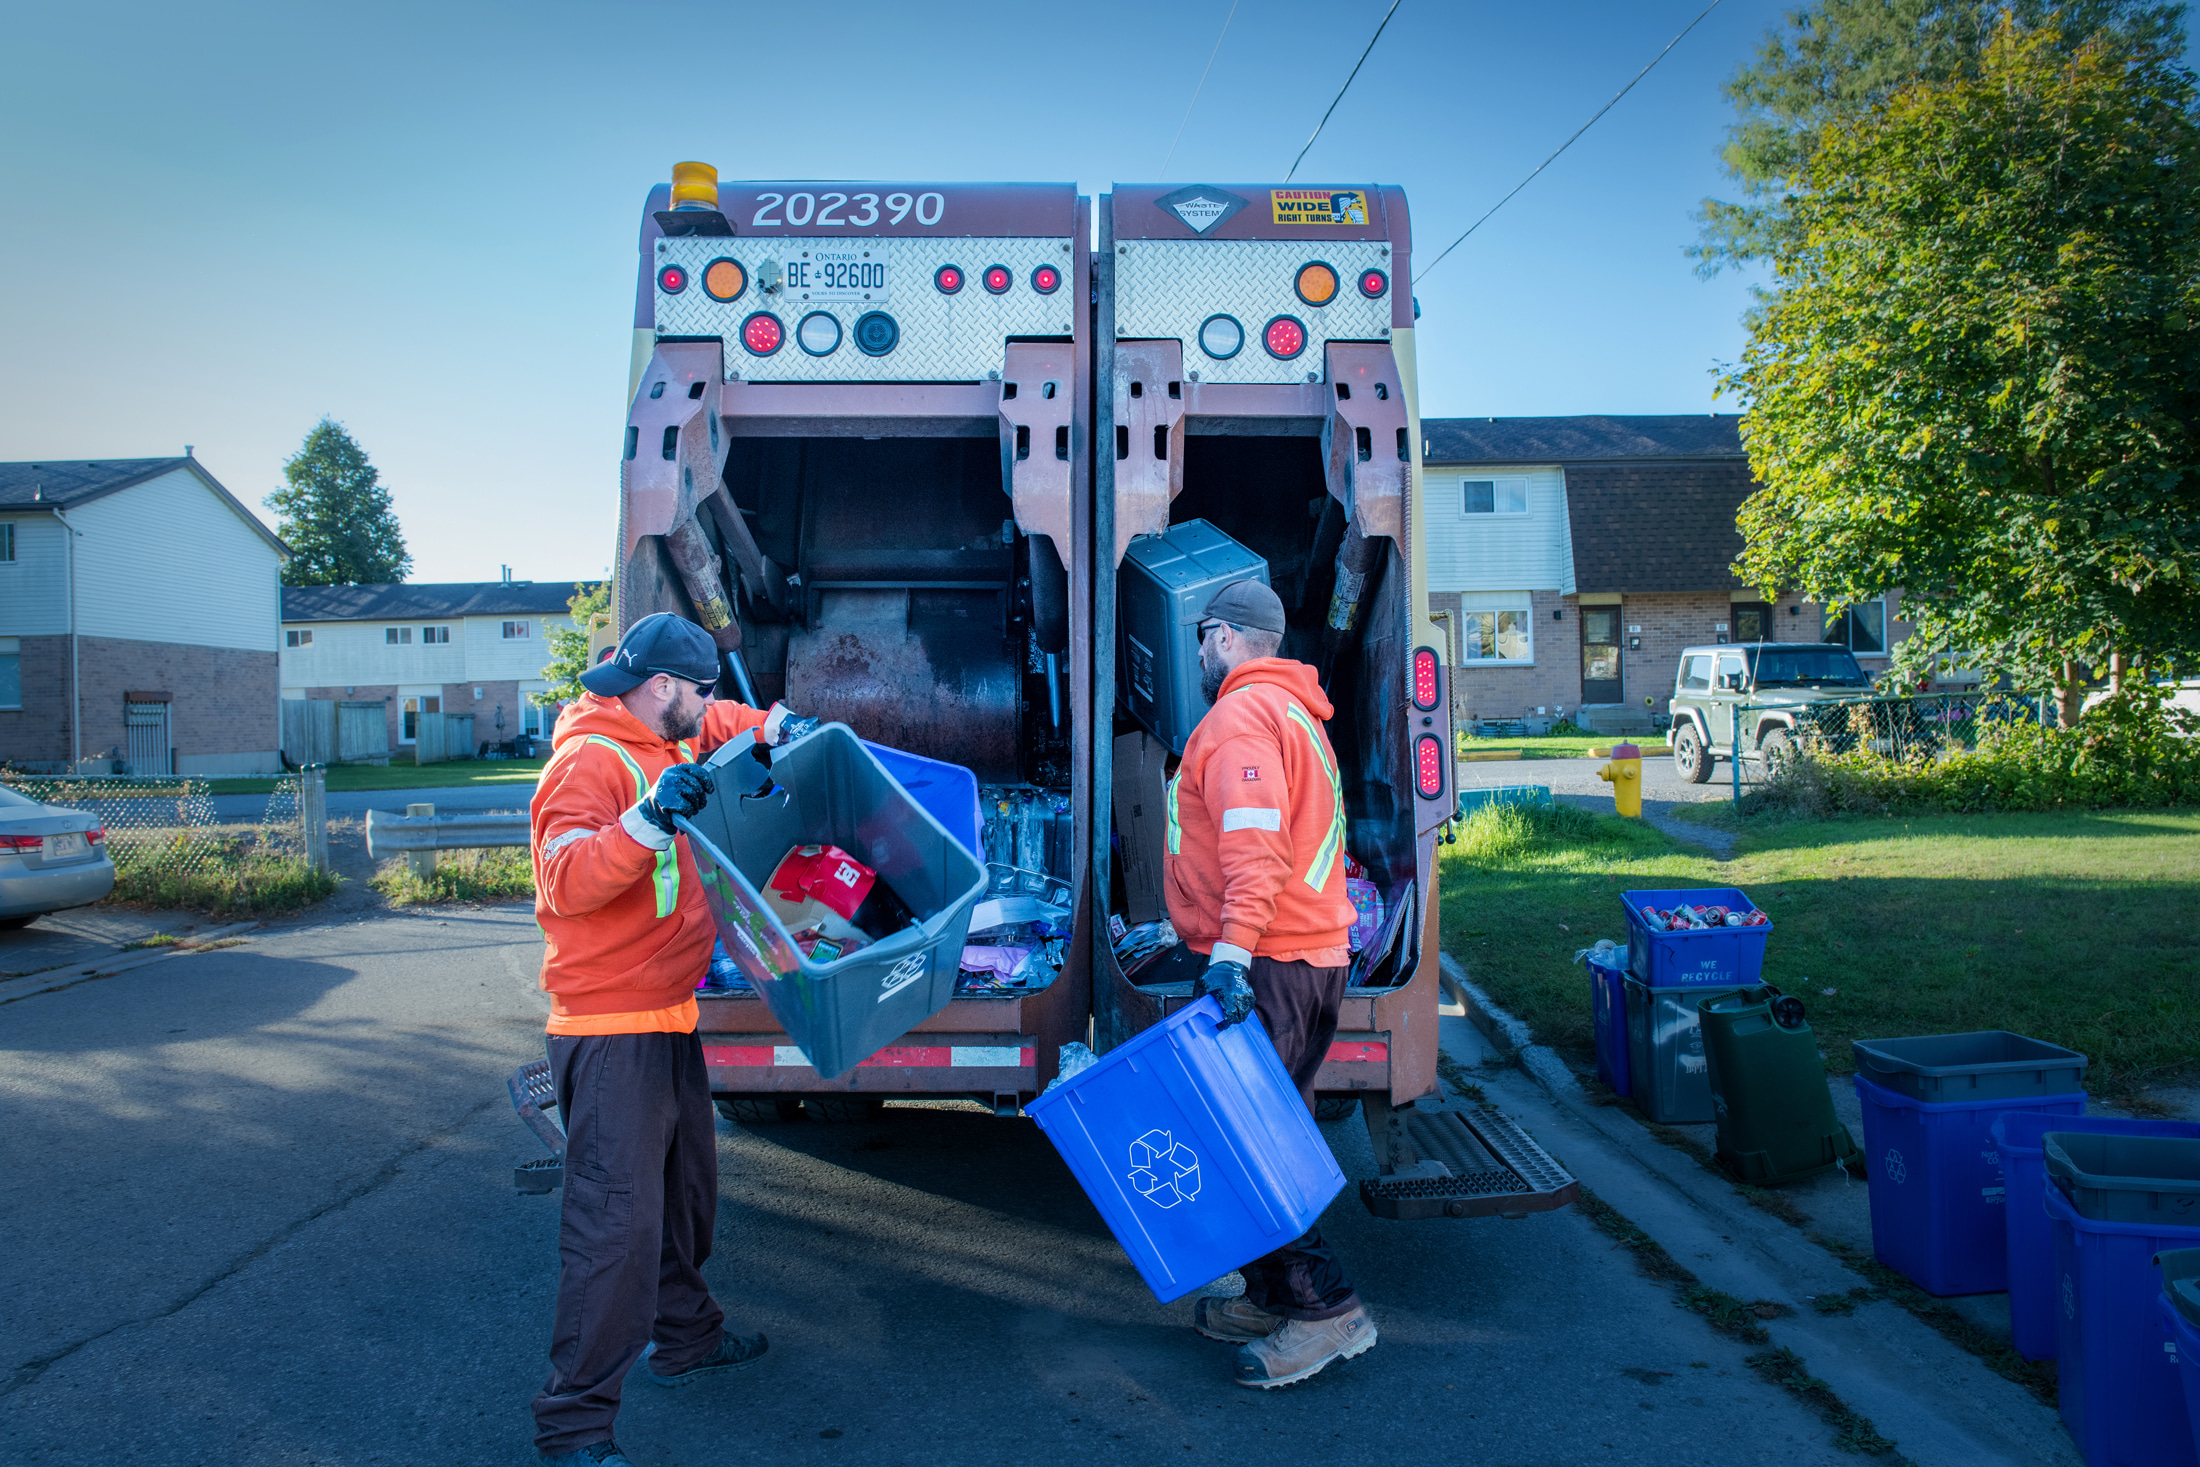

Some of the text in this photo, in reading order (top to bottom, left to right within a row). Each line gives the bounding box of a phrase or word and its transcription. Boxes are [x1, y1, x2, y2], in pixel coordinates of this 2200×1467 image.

[1275, 191, 1331, 200] CAUTION
[752, 192, 945, 227] 202390
[1277, 202, 1330, 211] WIDE
[1278, 214, 1332, 222] RIGHT TURNS
[815, 252, 857, 262] ONTARIO
[788, 262, 884, 288] BE 92600
[1700, 960, 1718, 969] WE
[1681, 971, 1733, 983] RECYCLE
